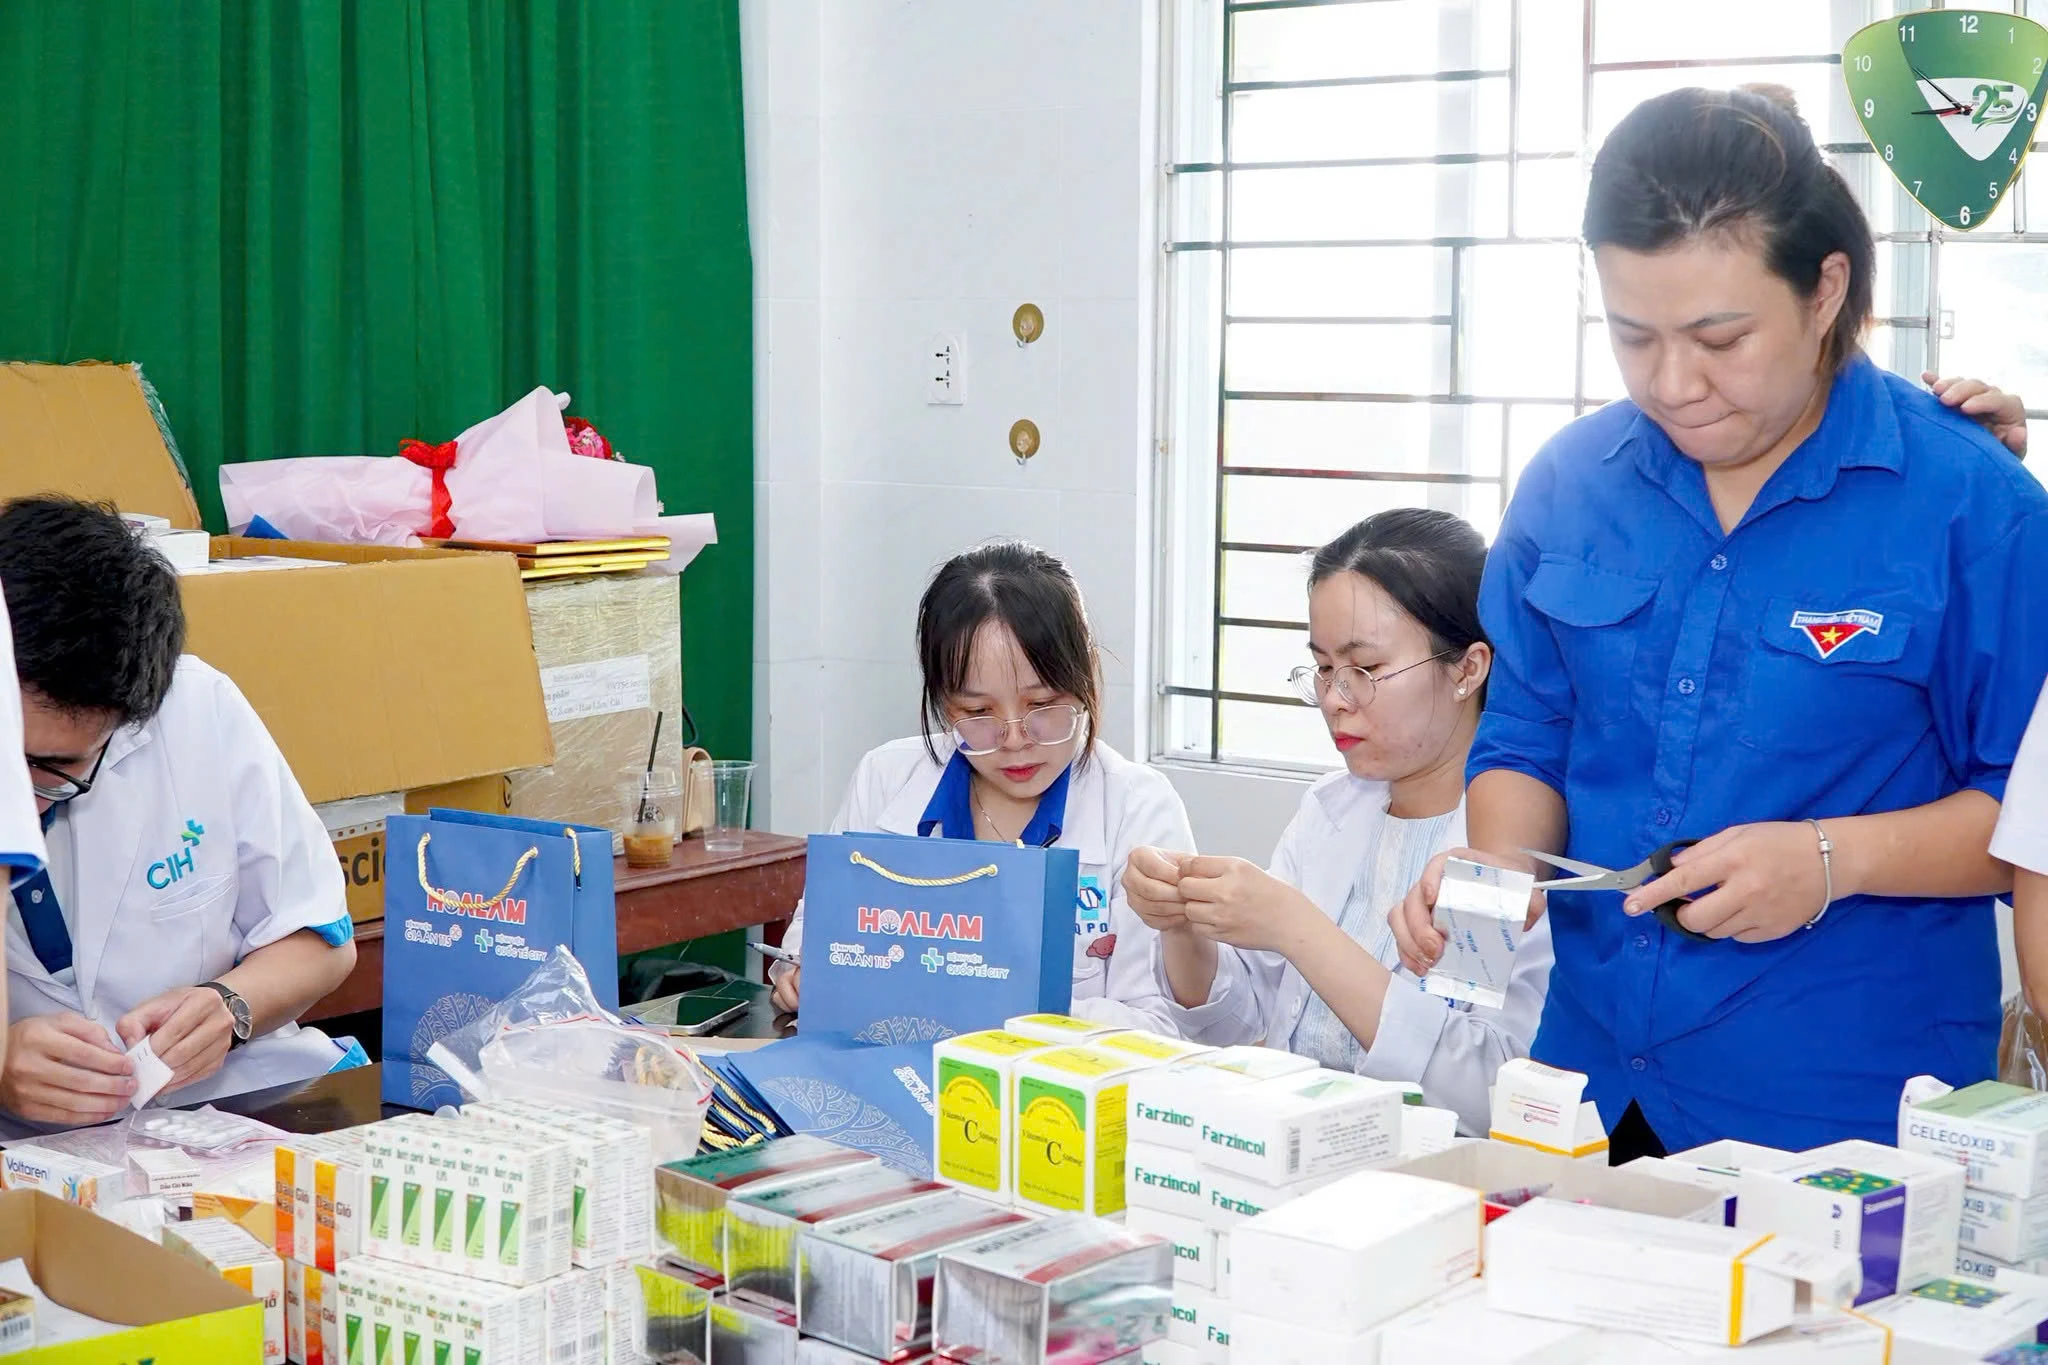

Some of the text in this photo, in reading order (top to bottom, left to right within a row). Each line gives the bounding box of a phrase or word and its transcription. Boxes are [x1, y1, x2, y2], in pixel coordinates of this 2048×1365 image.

[1899, 25, 1915, 42] 11
[1959, 15, 1979, 34] 12
[2008, 27, 2015, 44] 1
[1854, 55, 1872, 72] 10
[2032, 57, 2042, 75] 2
[1864, 98, 1875, 119] 9
[1972, 84, 2013, 124] 25
[2026, 102, 2037, 122] 3
[1884, 144, 1894, 162] 8
[2008, 147, 2018, 164] 4
[1913, 181, 1923, 197] 7
[1988, 182, 1998, 199] 5
[1959, 206, 1971, 225] 6
[147, 847, 194, 889] CIH
[339, 837, 386, 888] sci
[987, 967, 1010, 979] CITY
[1136, 1102, 1194, 1128] Farzinc
[964, 1119, 979, 1144] C
[1202, 1125, 1265, 1157] Farzincol
[1909, 1123, 1996, 1152] CELECOXIB
[1046, 1140, 1062, 1165] C
[6, 1157, 48, 1180] Voltaren
[1134, 1166, 1200, 1196] Farzincol
